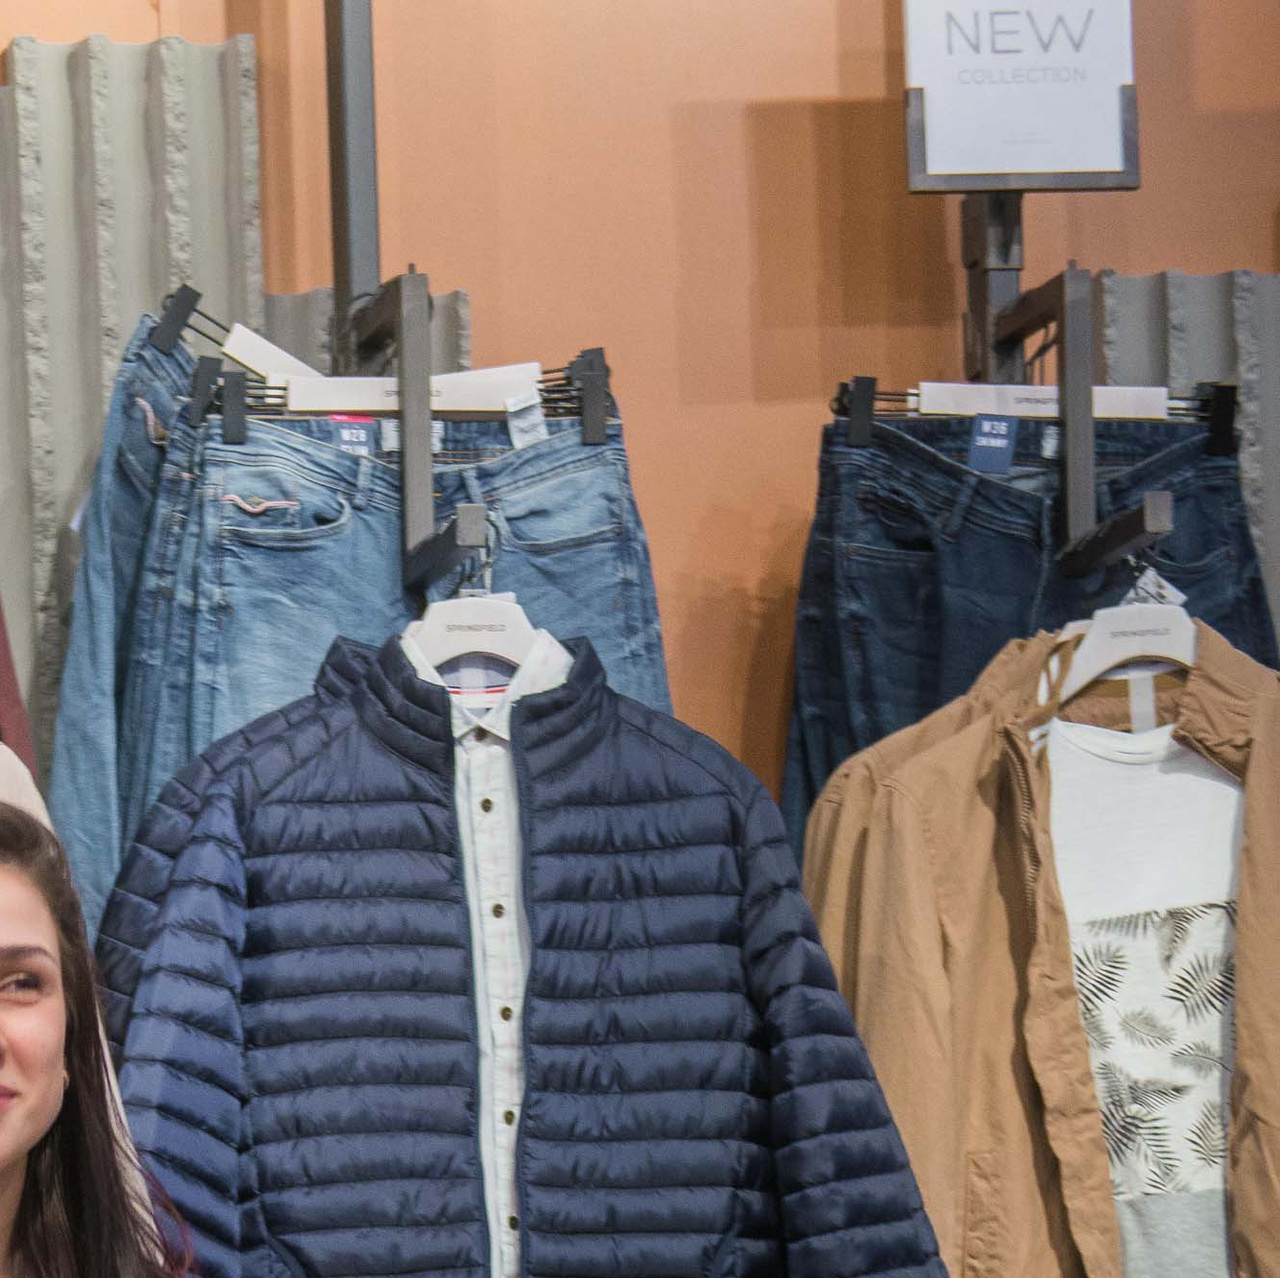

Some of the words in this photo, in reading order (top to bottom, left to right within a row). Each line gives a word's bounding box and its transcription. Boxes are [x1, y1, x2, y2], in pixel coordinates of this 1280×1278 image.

[945, 8, 1096, 55] NEW
[957, 66, 1089, 85] COLLECTION
[445, 623, 507, 633] SPRINGFIELD
